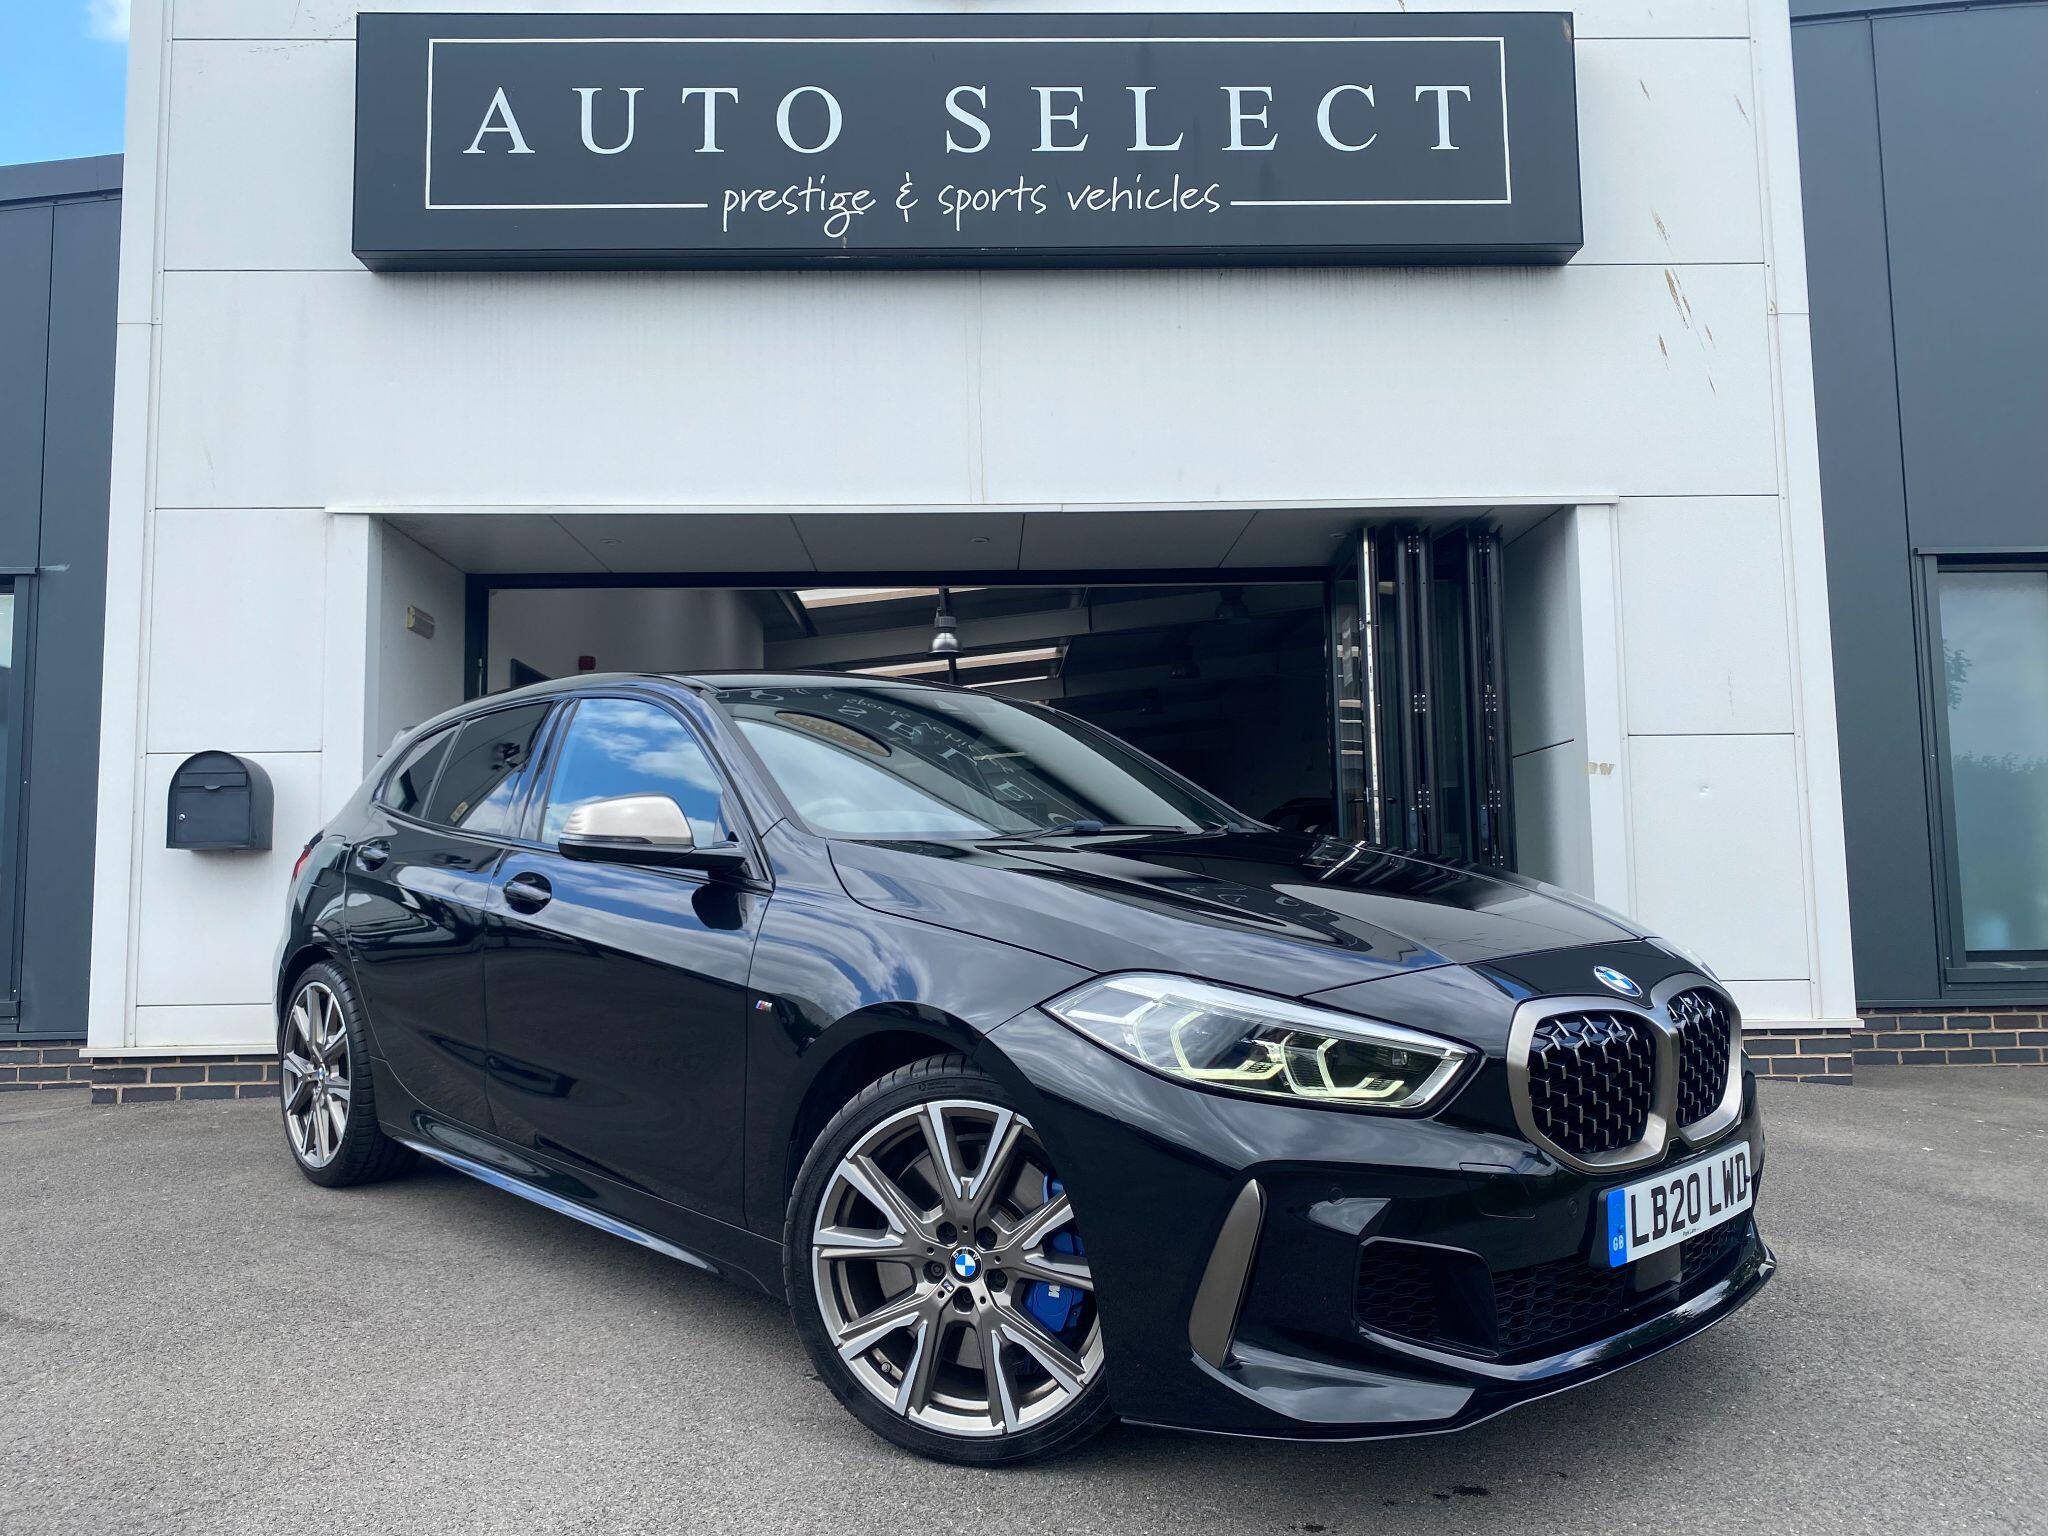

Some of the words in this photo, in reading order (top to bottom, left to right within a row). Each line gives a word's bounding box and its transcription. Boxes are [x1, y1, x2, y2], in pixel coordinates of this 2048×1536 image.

[462, 85, 843, 155] AUTO
[945, 84, 1472, 154] SELECT
[723, 174, 877, 238] prestige
[895, 171, 919, 223] &
[937, 175, 1047, 231] sports
[1067, 173, 1221, 213] vehicles
[1631, 1172, 1701, 1248] LB20
[1707, 1152, 1748, 1217] LWD
[1612, 1234, 1625, 1251] GB
